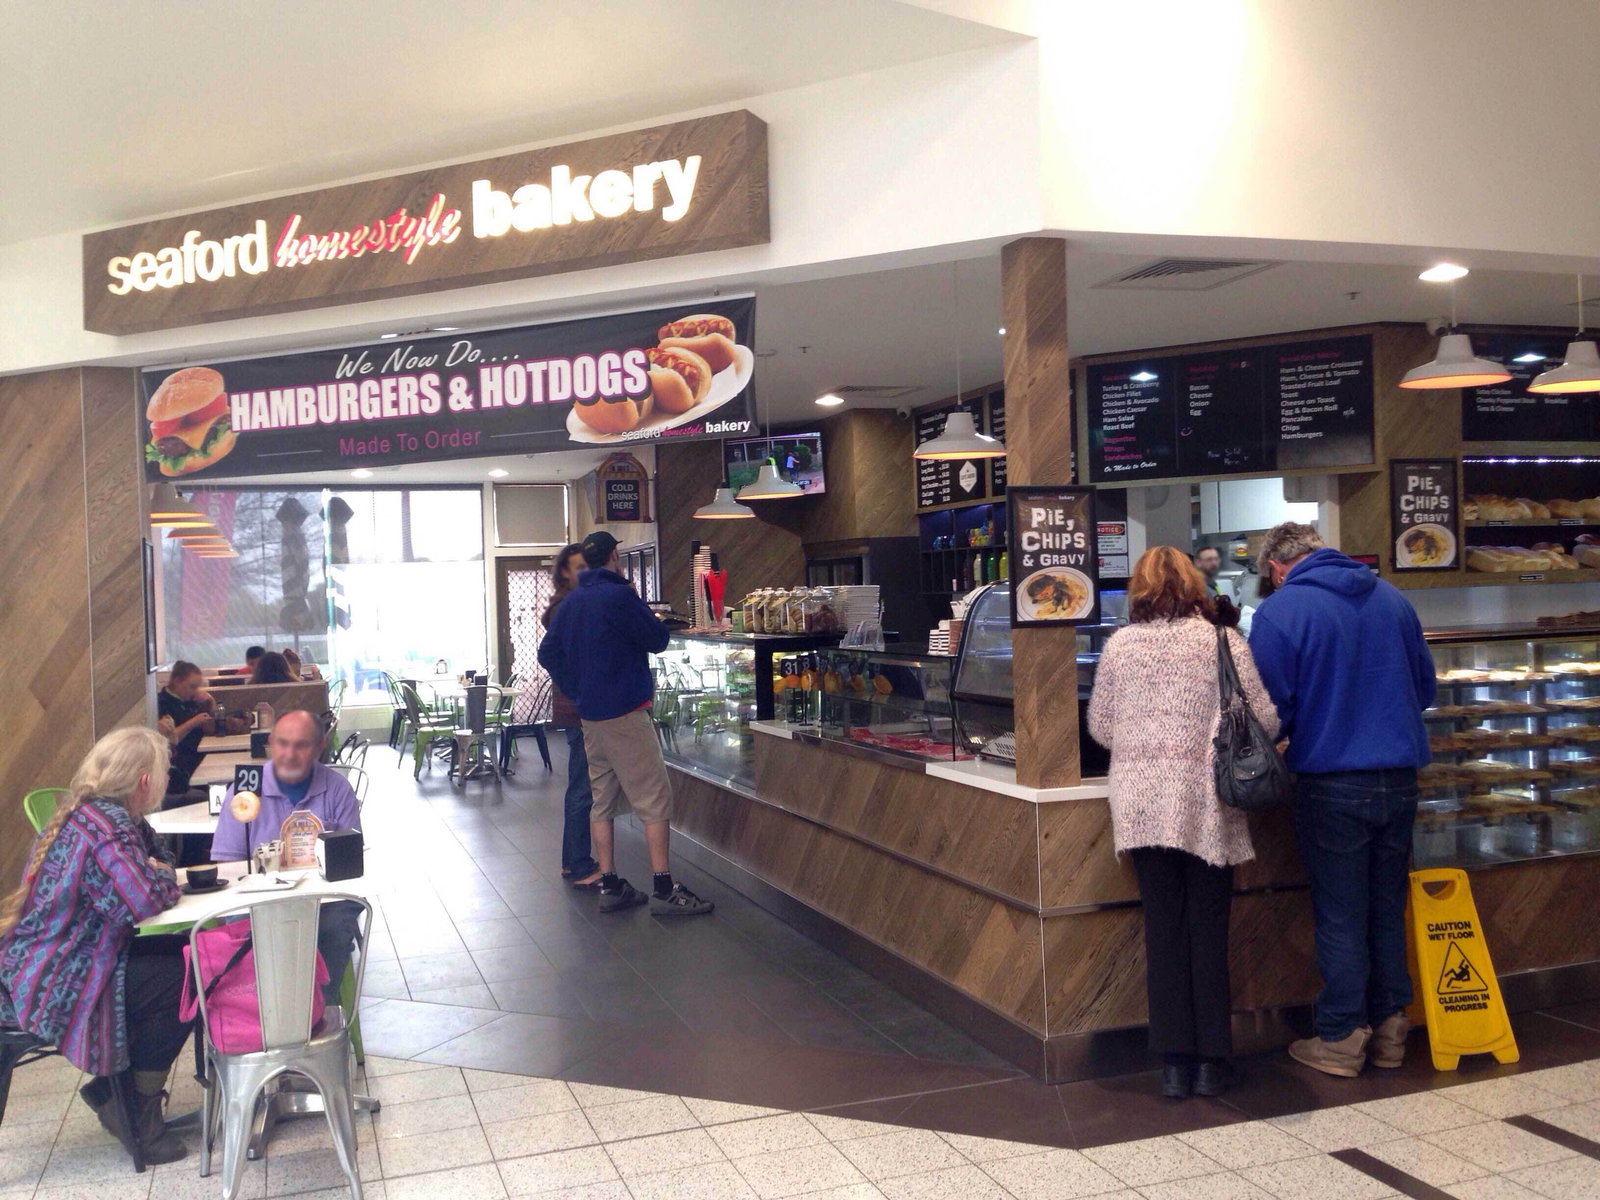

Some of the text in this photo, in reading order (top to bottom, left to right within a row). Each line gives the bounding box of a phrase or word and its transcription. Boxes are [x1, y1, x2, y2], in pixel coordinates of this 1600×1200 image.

[107, 155, 702, 295] seaford homestyle bakery
[335, 350, 375, 379] We
[381, 346, 439, 373] Now
[1305, 363, 1330, 371] Cheese
[1299, 372, 1324, 380] Cheese
[1334, 368, 1360, 377] Tomato
[1130, 381, 1159, 389] Cranberry
[1280, 378, 1341, 391] Toasted Fruit Loaf
[230, 349, 648, 432] HAMBURGERS & HOTDOGS
[1102, 392, 1125, 400] Chicken
[1280, 391, 1299, 399] Toast
[1133, 397, 1159, 405] Avocado
[1280, 400, 1305, 408] Cheese
[1126, 406, 1148, 414] Caesar
[1190, 409, 1202, 417] Egg
[1281, 408, 1294, 416] Egg
[1281, 415, 1313, 423] Pancakes
[1121, 422, 1135, 430] Beef
[1281, 424, 1300, 432] Chips
[621, 427, 661, 441] seaford
[705, 420, 751, 433] bakery
[1281, 431, 1324, 440] Hamburgers
[339, 430, 481, 456] Made To Order
[1113, 464, 1132, 472] Made
[611, 484, 634, 492] COLD
[607, 493, 639, 501] DRINKS
[612, 502, 634, 510] HERE
[1401, 513, 1411, 523] &
[1022, 554, 1034, 566] &
[785, 661, 798, 675] 31
[238, 769, 258, 792] 29
[1427, 921, 1471, 932] CAUTION
[1428, 931, 1475, 941] WET FLOOR
[1439, 993, 1490, 1004] CLEANING IN
[1444, 1002, 1488, 1013] PROGRESS
